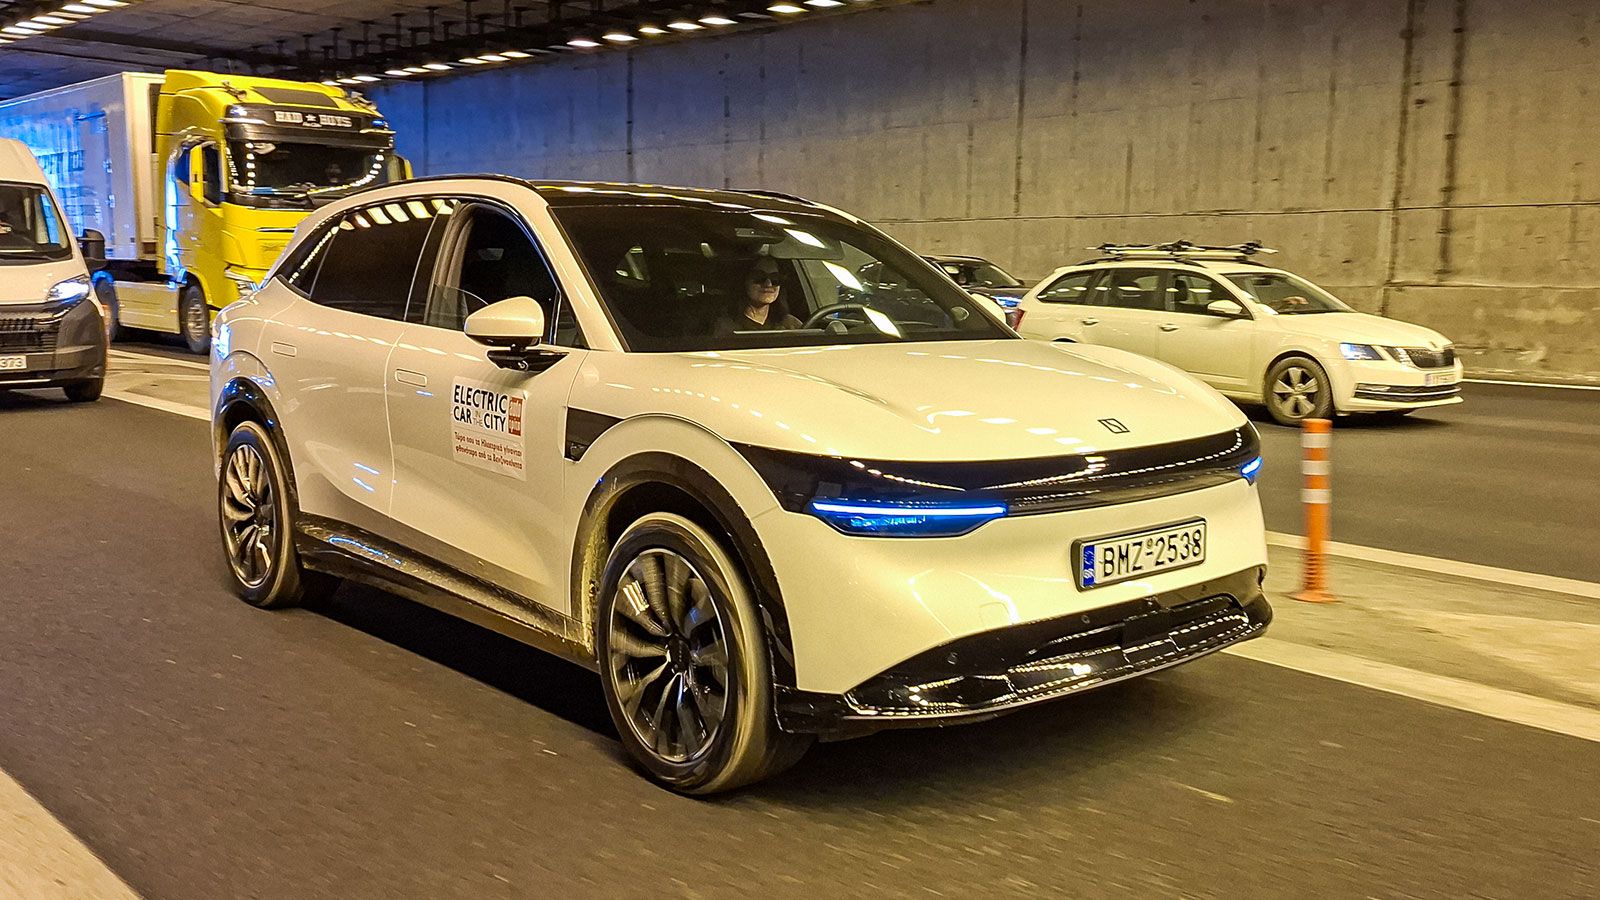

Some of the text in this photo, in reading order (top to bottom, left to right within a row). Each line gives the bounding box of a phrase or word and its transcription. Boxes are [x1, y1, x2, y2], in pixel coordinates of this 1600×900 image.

[319, 115, 352, 128] BOYS
[453, 384, 508, 414] ELECTRIC
[453, 405, 473, 425] CAR
[483, 413, 506, 432] CITY
